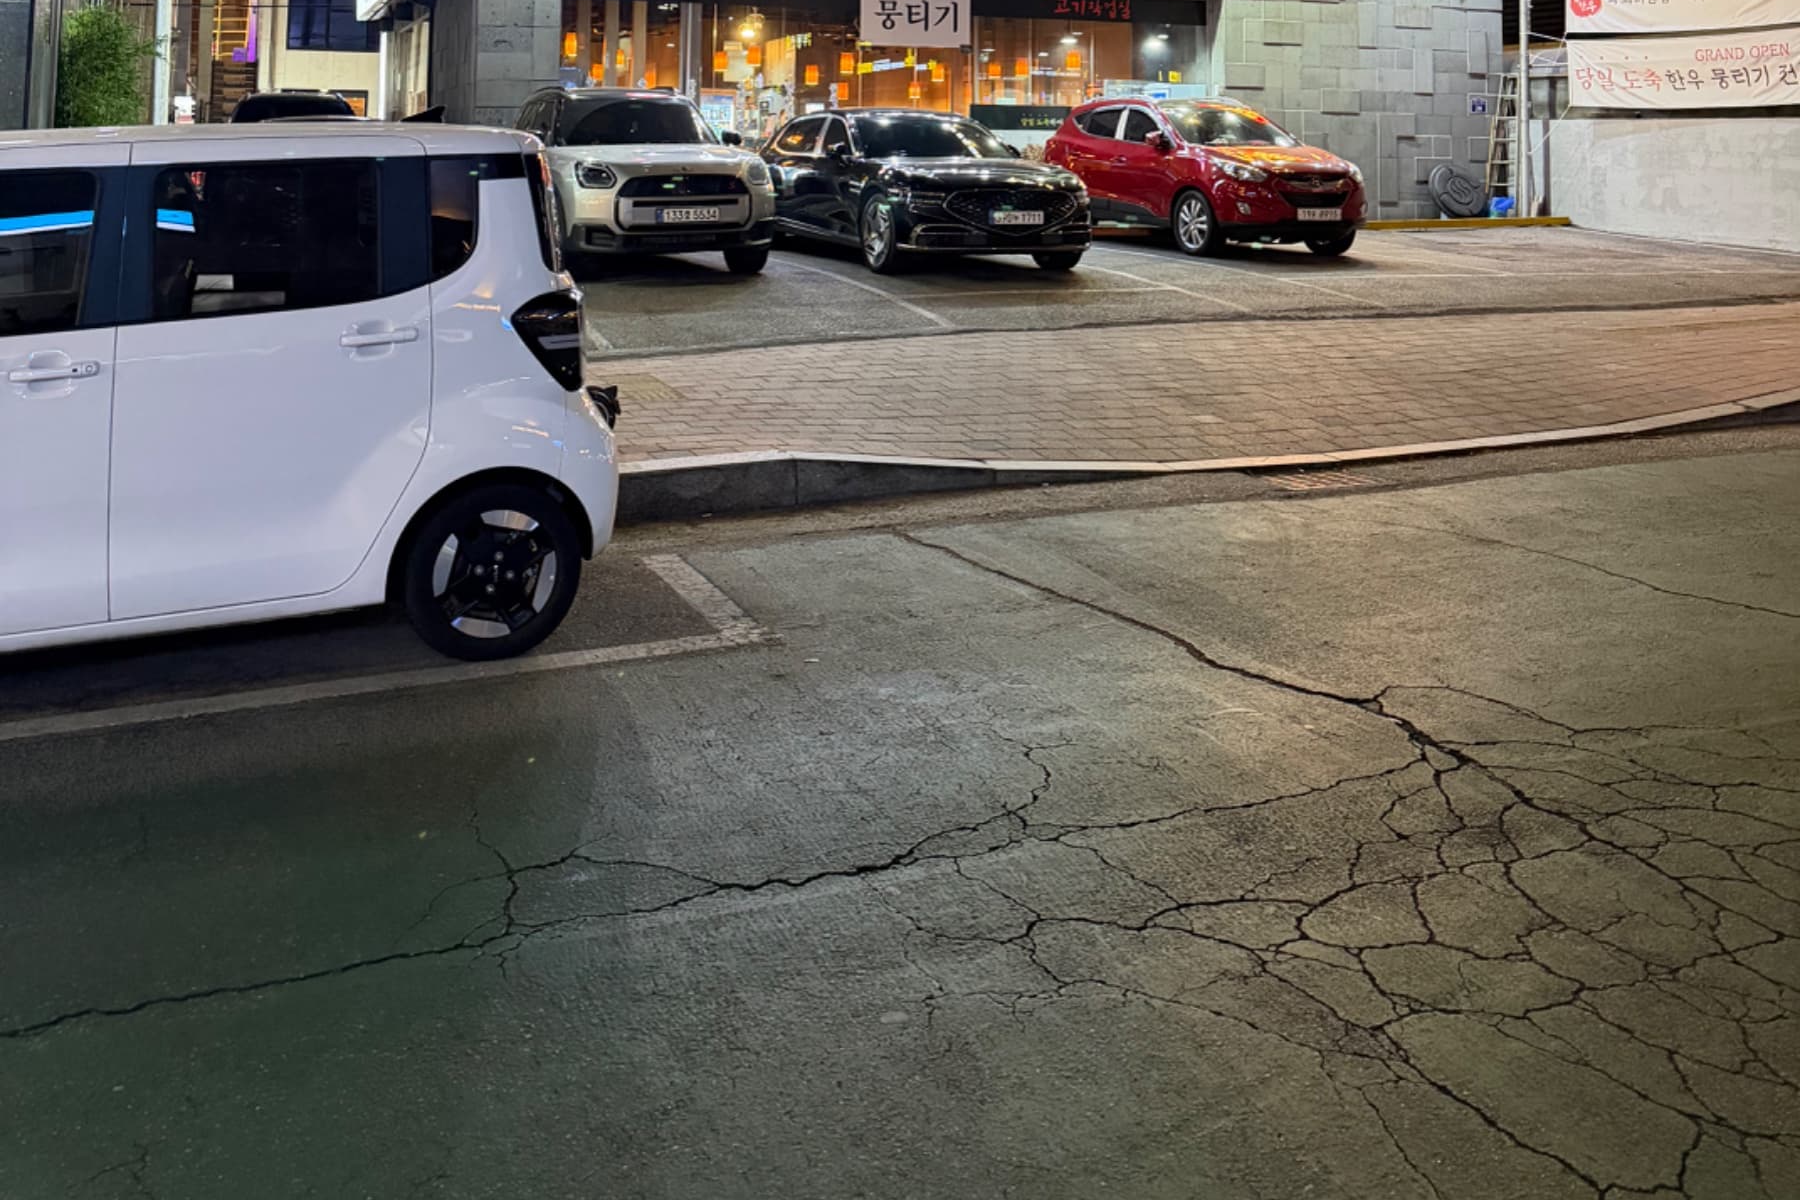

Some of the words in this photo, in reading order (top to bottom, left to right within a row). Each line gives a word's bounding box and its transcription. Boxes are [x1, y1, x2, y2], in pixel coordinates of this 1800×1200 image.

[873, 0, 958, 33] 뭉티기
[1695, 48, 1745, 63] GRAND
[1750, 43, 1790, 58] OPEN
[1576, 67, 1615, 92] 당일
[1624, 68, 1662, 92] 도축
[1665, 70, 1704, 91] 한우
[1711, 66, 1770, 89] 뭉티기
